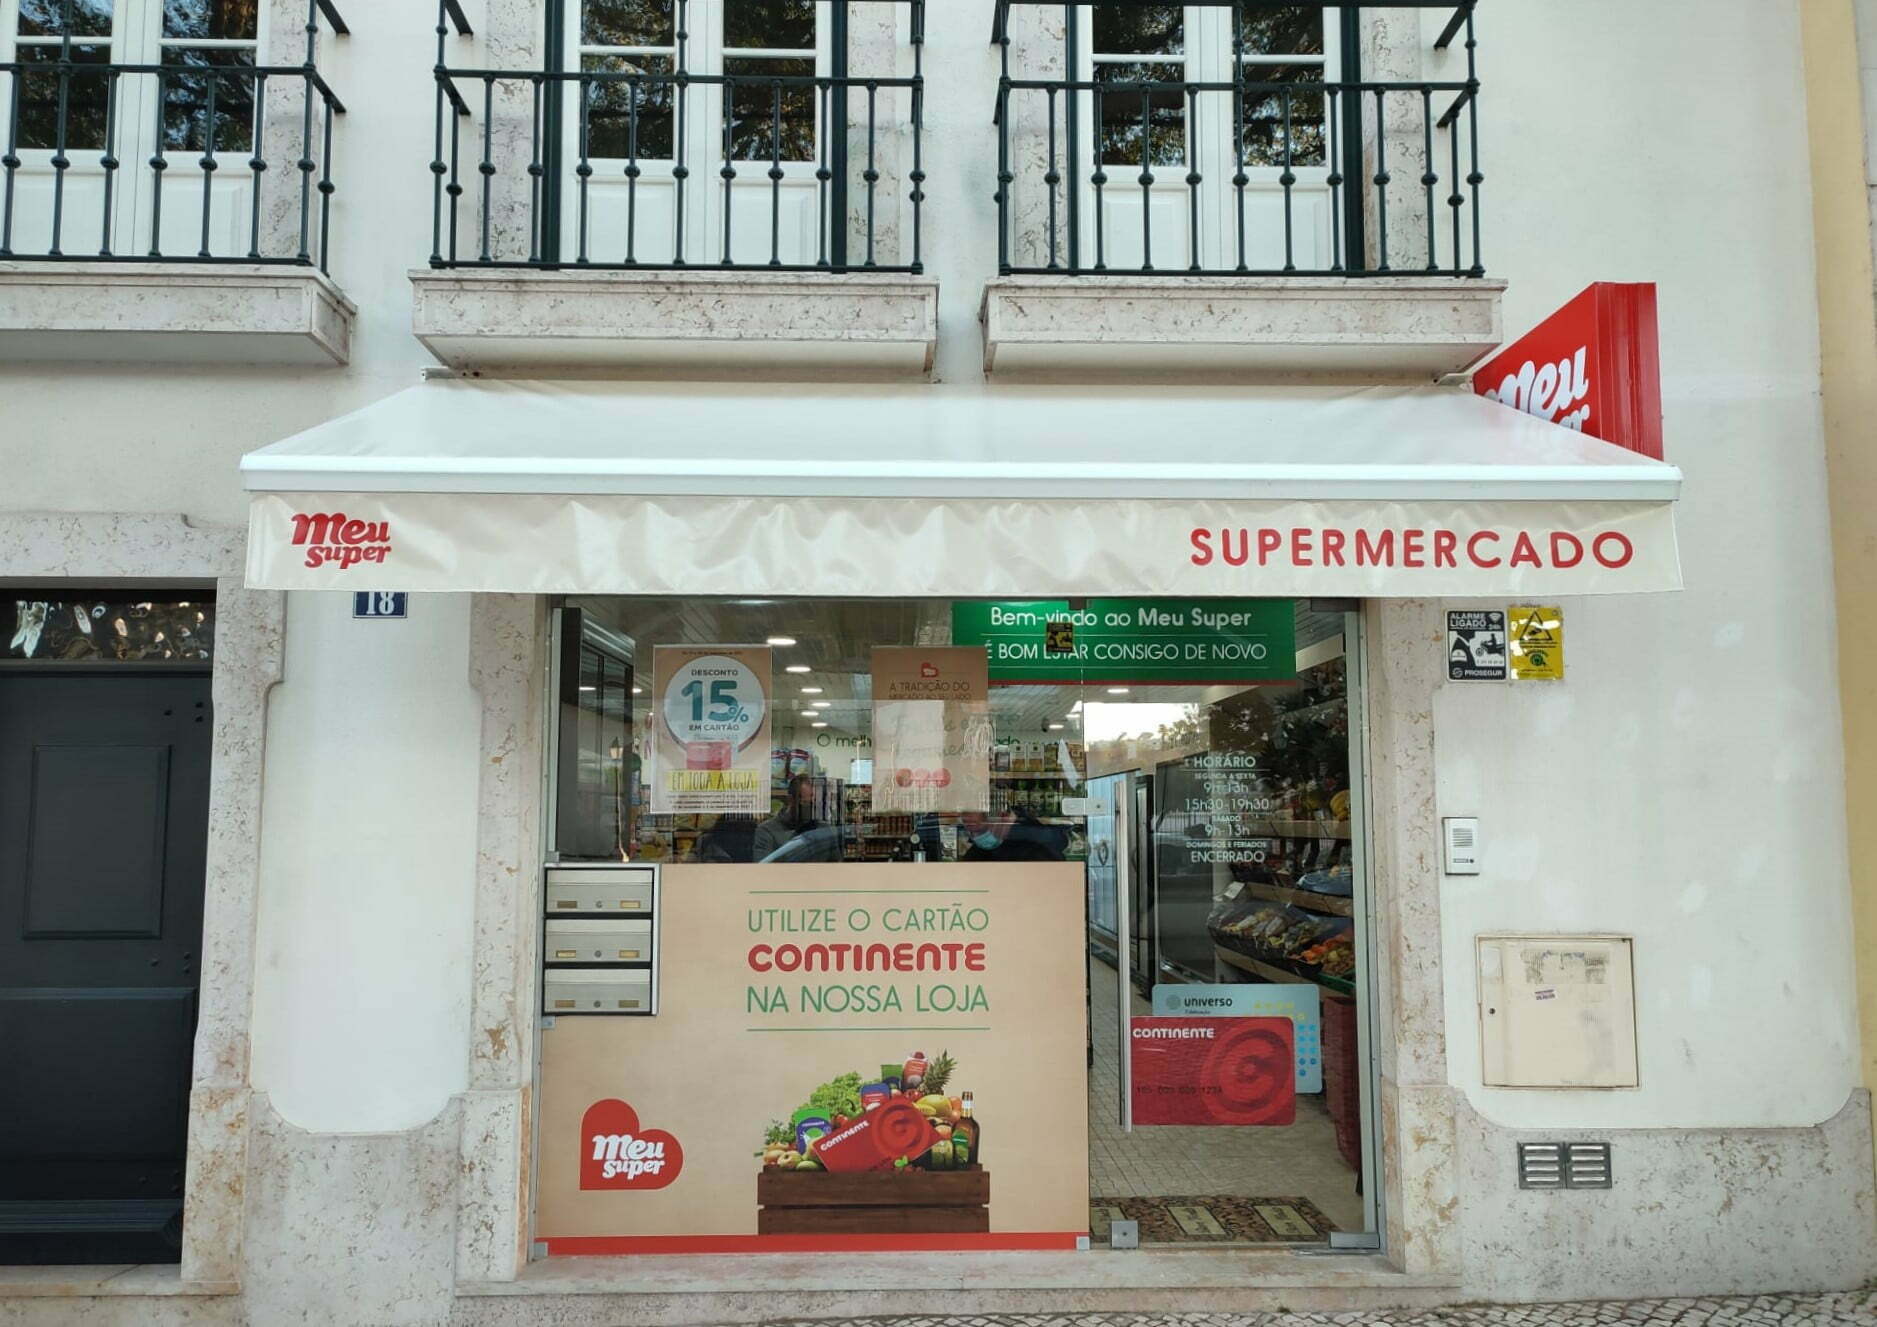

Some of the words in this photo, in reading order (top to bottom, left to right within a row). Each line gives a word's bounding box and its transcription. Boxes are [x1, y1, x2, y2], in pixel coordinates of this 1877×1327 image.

[1190, 527, 1634, 569] SUPERMERCADO
[304, 545, 392, 569] super
[366, 592, 395, 615] 18
[991, 606, 1098, 626] Bem-vindo
[1104, 612, 1131, 626] ao
[1138, 607, 1184, 626] Meu
[1191, 607, 1252, 630] Super
[1450, 619, 1487, 628] LIGADO
[998, 643, 1038, 660] BOM
[1094, 643, 1179, 660] CONSIGO
[1184, 643, 1207, 660] DE
[1212, 643, 1267, 660] NOVO
[691, 668, 739, 677] DESCONTO
[1464, 669, 1503, 677] PROSEGUR
[681, 679, 749, 723] 15%
[688, 723, 702, 732] EM
[703, 721, 740, 732] CARTÃO
[835, 734, 873, 748] melh
[1194, 753, 1257, 768] HORÁRIO
[1191, 850, 1266, 863] ENCERRADO
[749, 908, 837, 933] UTILIZE
[848, 908, 870, 932] O
[882, 902, 989, 932] CARTÃO
[748, 943, 986, 973] CONTINENTE
[747, 985, 789, 1014] NA
[801, 985, 902, 1013] NOSSA
[916, 984, 990, 1013] LOJA
[1184, 995, 1233, 1008] universo
[1132, 1027, 1216, 1039] CONTINENTE
[602, 1159, 666, 1181] super
